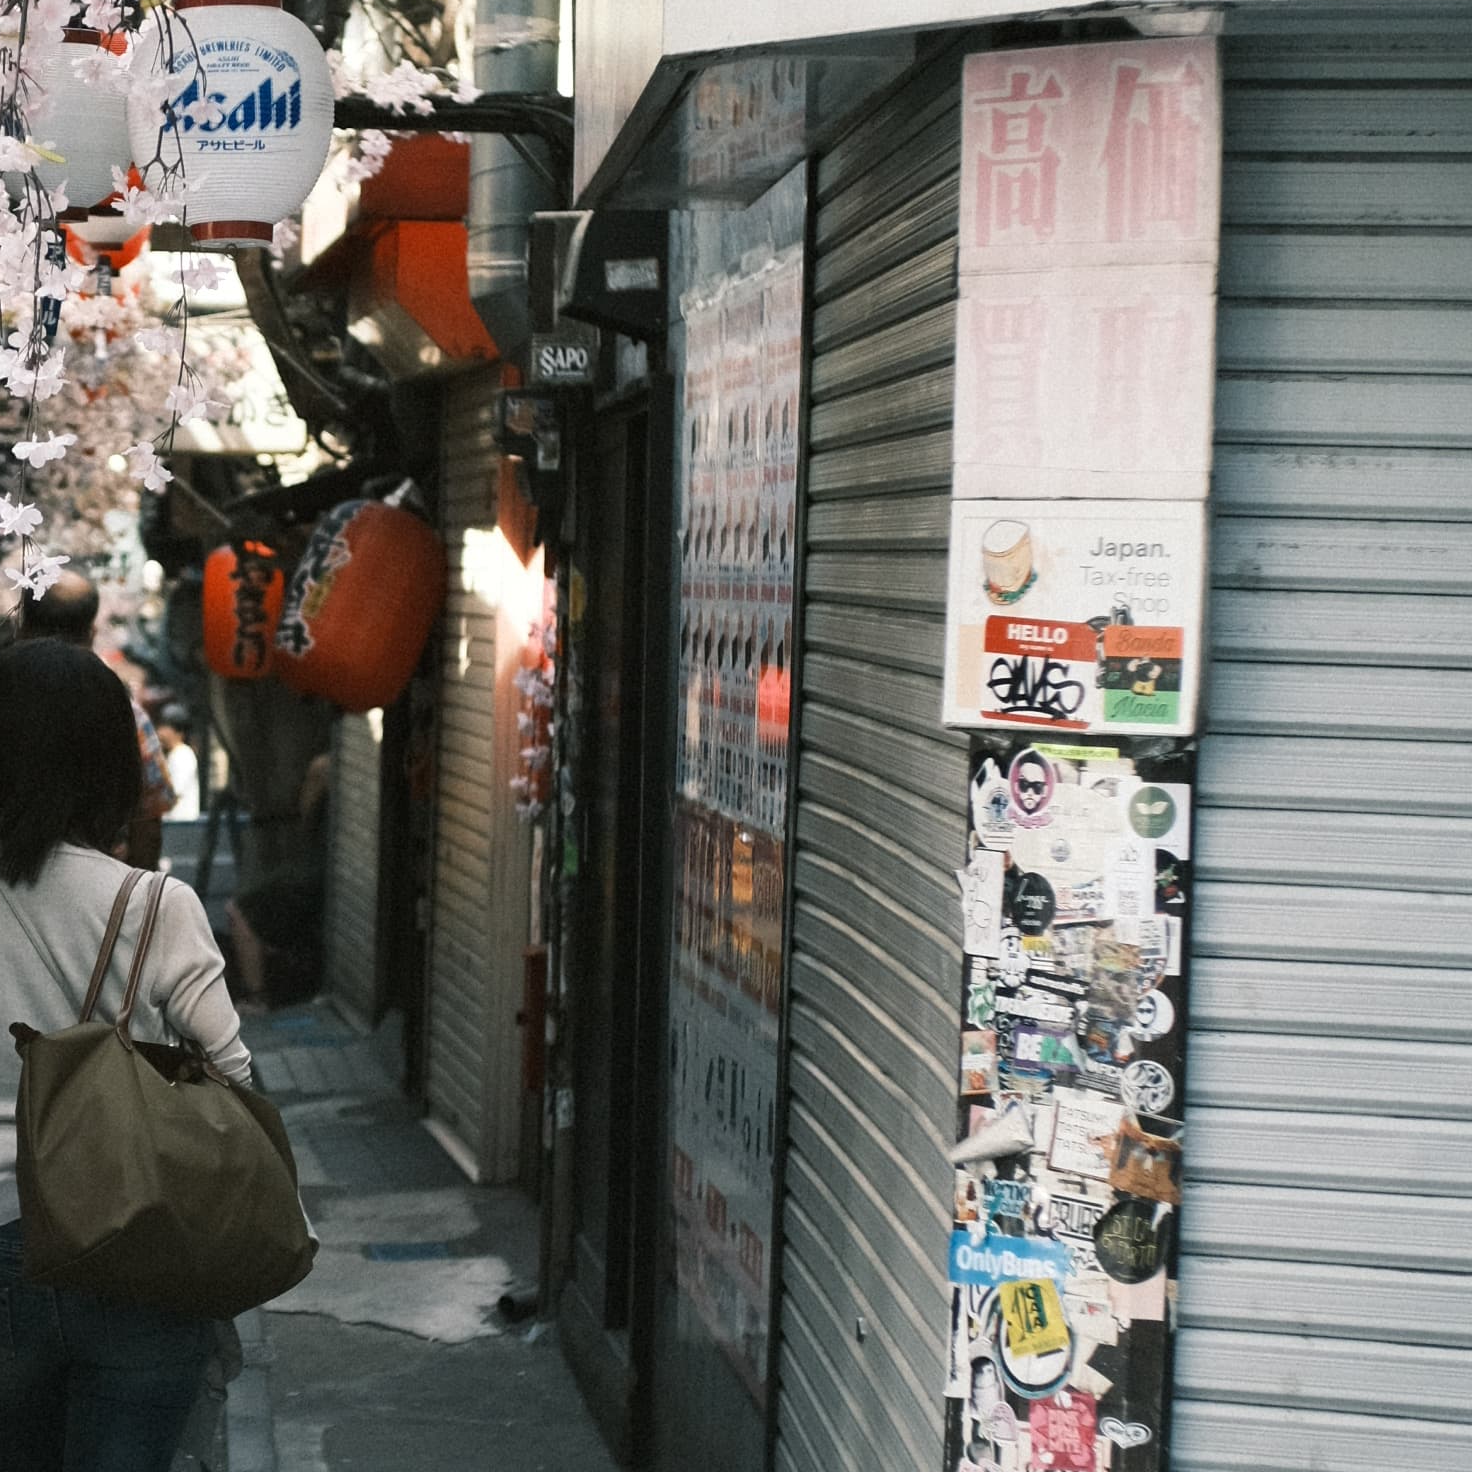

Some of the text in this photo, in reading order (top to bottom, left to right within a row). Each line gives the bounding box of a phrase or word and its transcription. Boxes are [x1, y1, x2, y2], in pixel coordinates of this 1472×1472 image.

[196, 139, 266, 152] アサヒビール
[972, 58, 1207, 248] 高価
[1089, 536, 1171, 562] Japan.
[1079, 565, 1173, 587] Tax-free
[1006, 623, 1069, 645] HELLO
